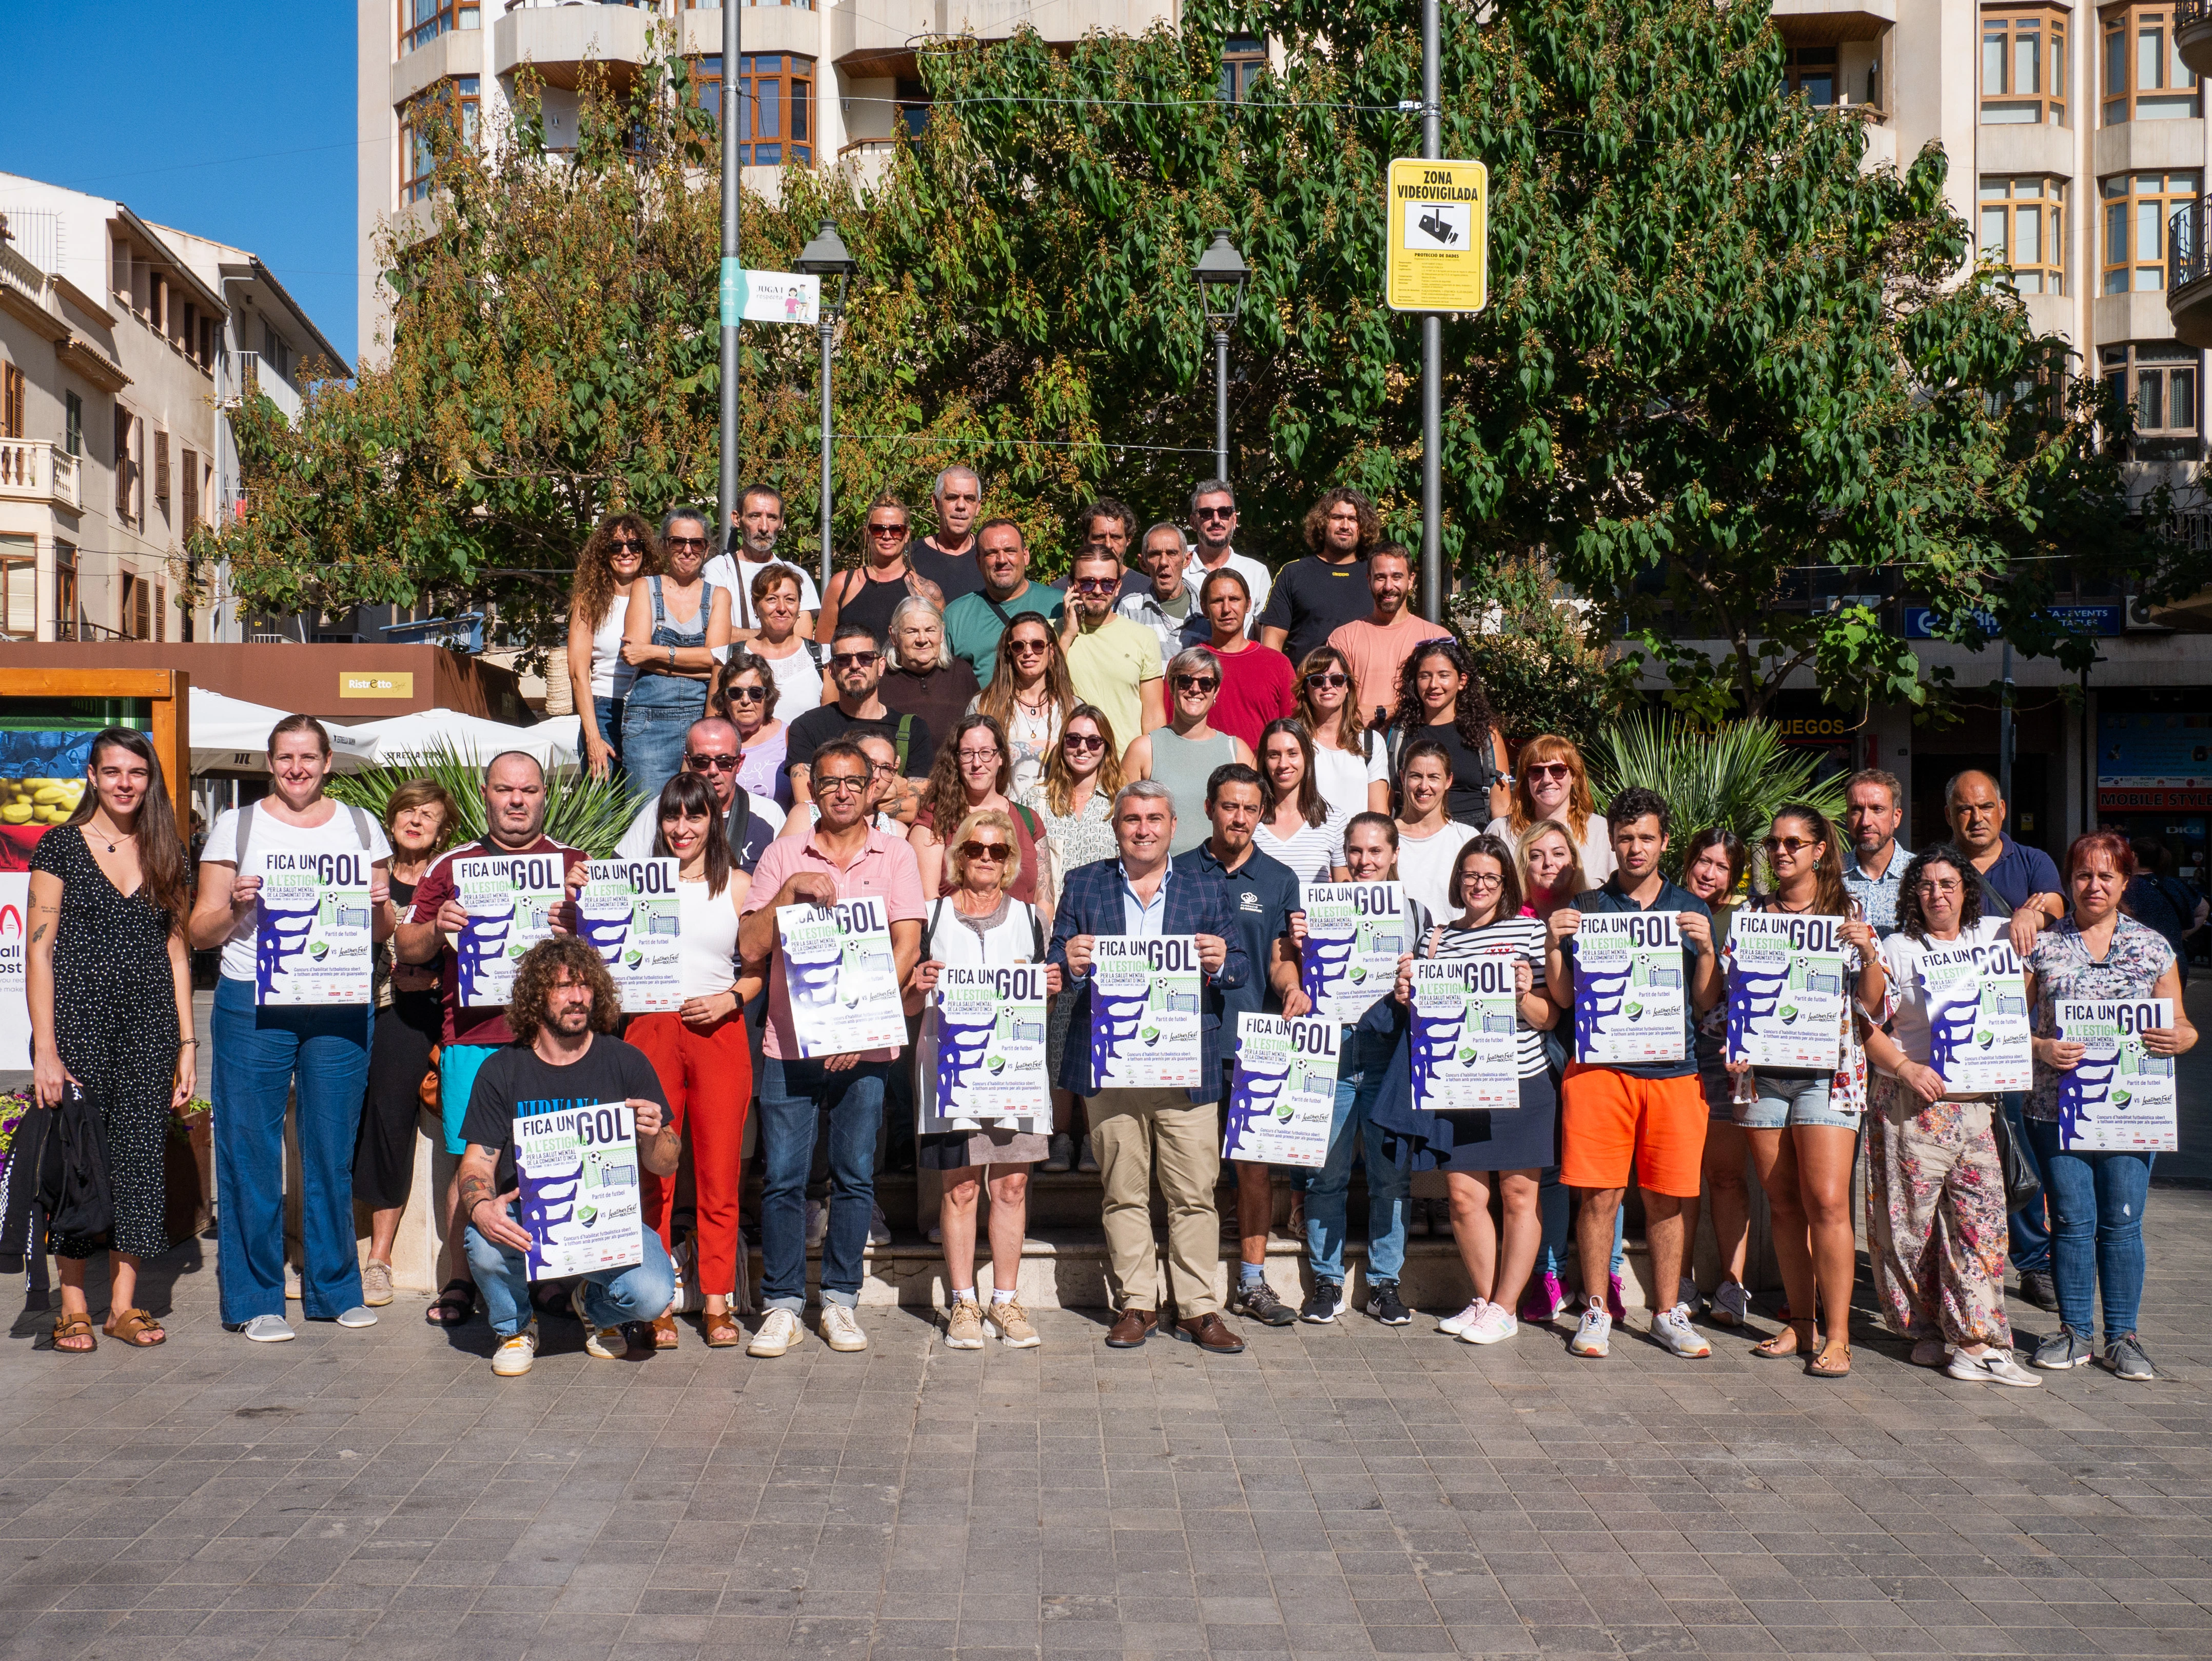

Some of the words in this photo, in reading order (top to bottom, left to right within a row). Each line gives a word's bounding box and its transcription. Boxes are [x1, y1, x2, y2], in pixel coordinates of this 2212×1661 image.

[1424, 171, 1452, 185] ZONA
[1397, 185, 1478, 201] VIDEOVIGILADA
[756, 285, 779, 294] JUGA
[349, 679, 392, 689] Ristretto
[1779, 719, 1845, 735] UEGOS
[2101, 793, 2163, 805] MOBILE
[2168, 793, 2212, 805] STYLE
[267, 854, 296, 869] FICA
[300, 855, 316, 870] UN
[318, 854, 367, 886] GOL
[462, 862, 489, 878] FICA
[493, 861, 509, 876] UN
[511, 859, 560, 890] GOL
[267, 875, 275, 886] A
[277, 874, 326, 887] L'ESTIGMA
[612, 864, 628, 880] UN
[629, 862, 676, 894] GOL
[463, 883, 470, 894] A
[473, 880, 520, 894] L'ESTIGMA
[584, 885, 591, 896] A
[594, 883, 639, 896] L'ESTIGMA
[1308, 888, 1334, 902] FICA
[1337, 888, 1352, 901] UN
[1354, 886, 1400, 915] GOL
[817, 907, 834, 921] UN
[832, 901, 885, 934] GOL
[1309, 907, 1316, 917] A
[1317, 905, 1363, 918] L'ESTIGMA
[791, 930, 797, 941] A
[799, 924, 846, 940] L'ESTIGMA
[1581, 919, 1608, 933] FICA
[1612, 917, 1628, 932] UN
[1629, 916, 1680, 948] GOL
[1740, 917, 1768, 933] FICA
[1772, 919, 1788, 934] UN
[1789, 919, 1842, 952] GOL
[1582, 937, 1589, 950] A
[1591, 936, 1639, 950] L'ESTIGMA
[1740, 937, 1746, 949] A
[1749, 937, 1798, 951] L'ESTIGMA
[1100, 941, 1127, 956] FICA
[1130, 941, 1146, 956] UN
[1148, 939, 1199, 971] GOL
[1922, 953, 1951, 967] FICA
[1953, 949, 1971, 963] UN
[1971, 944, 2020, 975] GOL
[1100, 961, 1107, 972] A
[1109, 960, 1157, 973] L'ESTIGMA
[1419, 964, 1444, 979] FICA
[1447, 964, 1462, 978] UN
[1464, 962, 1512, 993] GOL
[1928, 970, 1934, 980] A
[948, 969, 974, 984] FICA
[978, 969, 994, 984] UN
[995, 968, 1043, 1000] GOL
[1419, 984, 1425, 994] A
[1427, 983, 1473, 995] L'ESTIGMA
[948, 989, 954, 1000] A
[956, 989, 1004, 1001] L'ESTIGMA
[2065, 1005, 2094, 1020] FICA
[2098, 1005, 2115, 1020] UN
[1246, 1019, 1271, 1034] FICA
[1276, 1020, 1291, 1035] UN
[1291, 1022, 1336, 1056] GOL
[2066, 1025, 2073, 1035] A
[2076, 1024, 2127, 1036] L'ESTIGMA
[1245, 1037, 1251, 1048] A
[1254, 1038, 1299, 1052] L'ESTIGMA
[523, 1118, 553, 1137] FICA
[557, 1115, 575, 1131] UN
[576, 1105, 631, 1145] GOL
[526, 1141, 533, 1154] A
[535, 1134, 588, 1152] L'ESTIGMA
[539, 1156, 562, 1164] COMUNITAT
